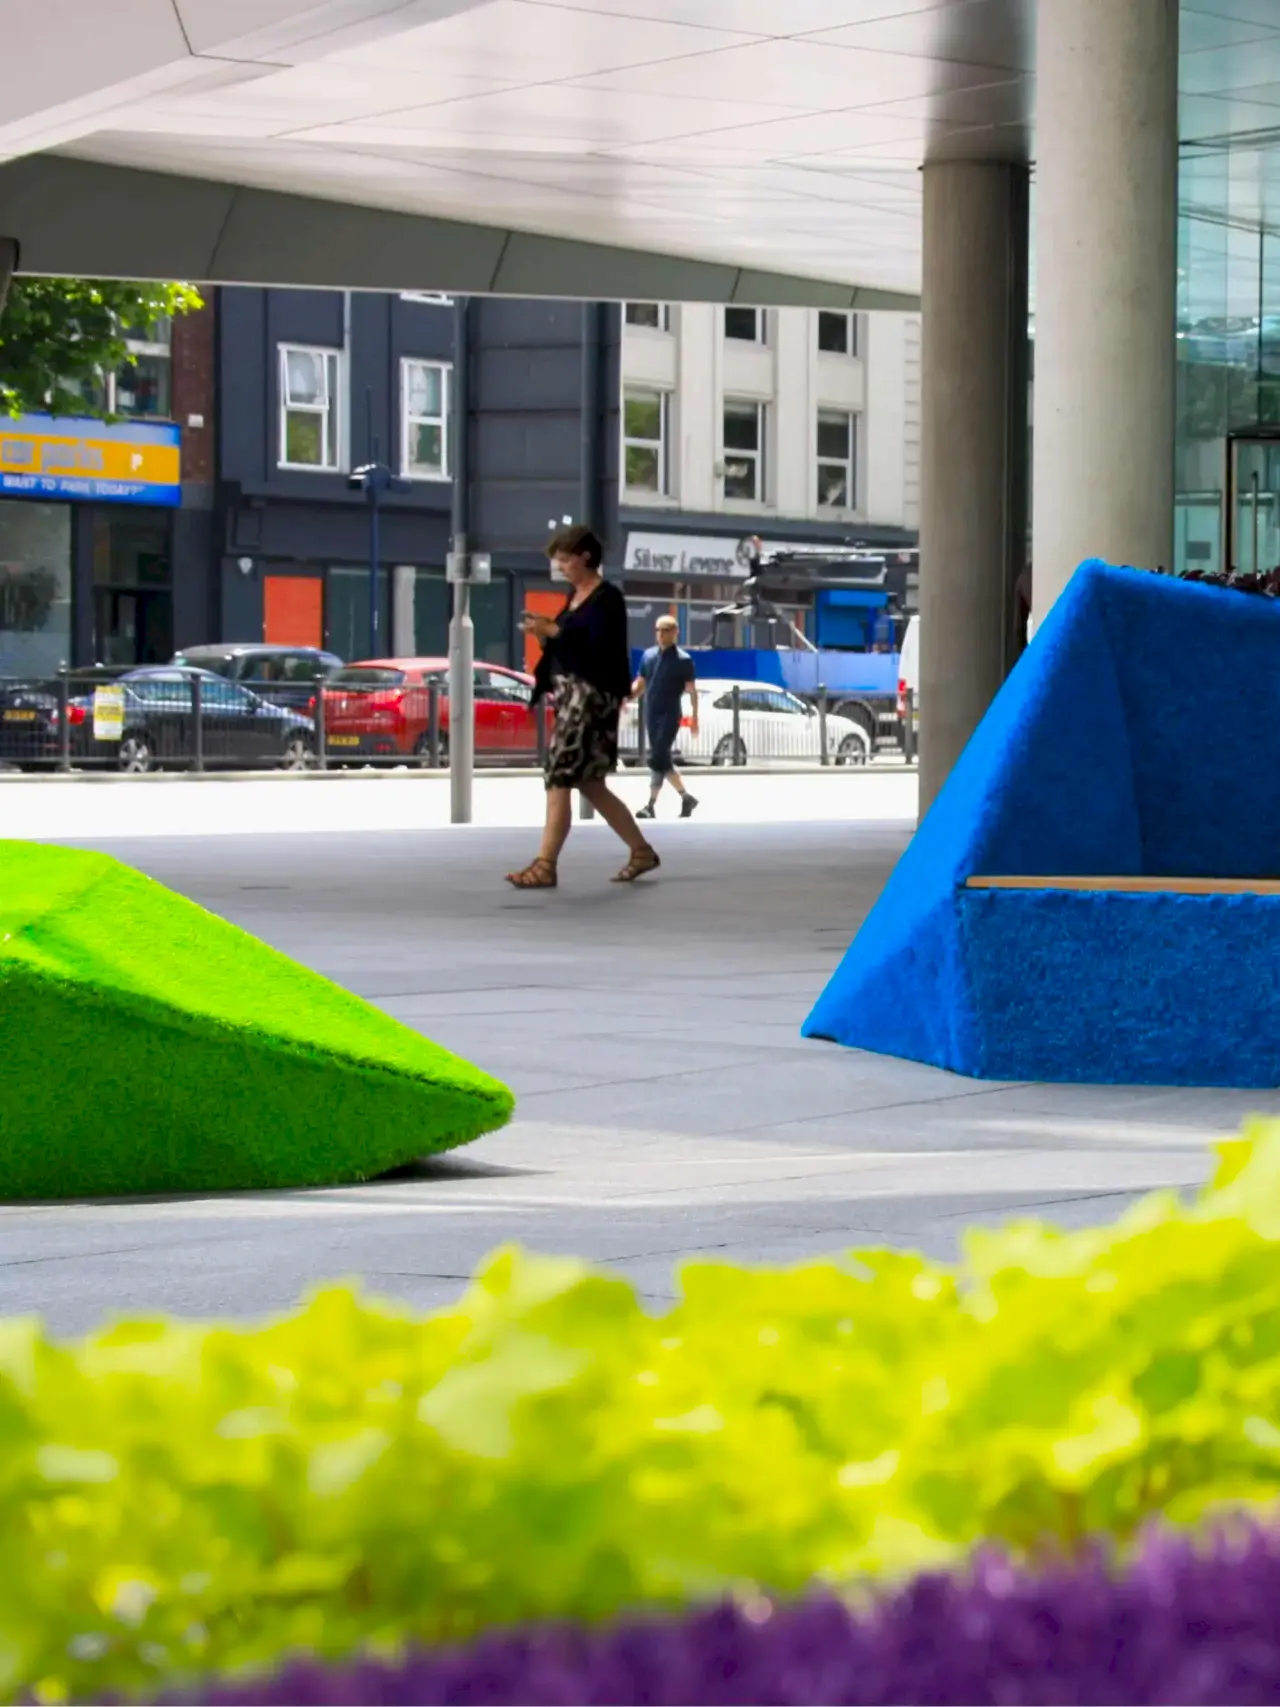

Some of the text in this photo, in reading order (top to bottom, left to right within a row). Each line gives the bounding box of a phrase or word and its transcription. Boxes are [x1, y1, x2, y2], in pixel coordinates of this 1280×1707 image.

[3, 475, 37, 489] WANT
[41, 478, 56, 490] TO
[60, 479, 91, 494] PARK
[633, 547, 734, 575] Silver Levene
